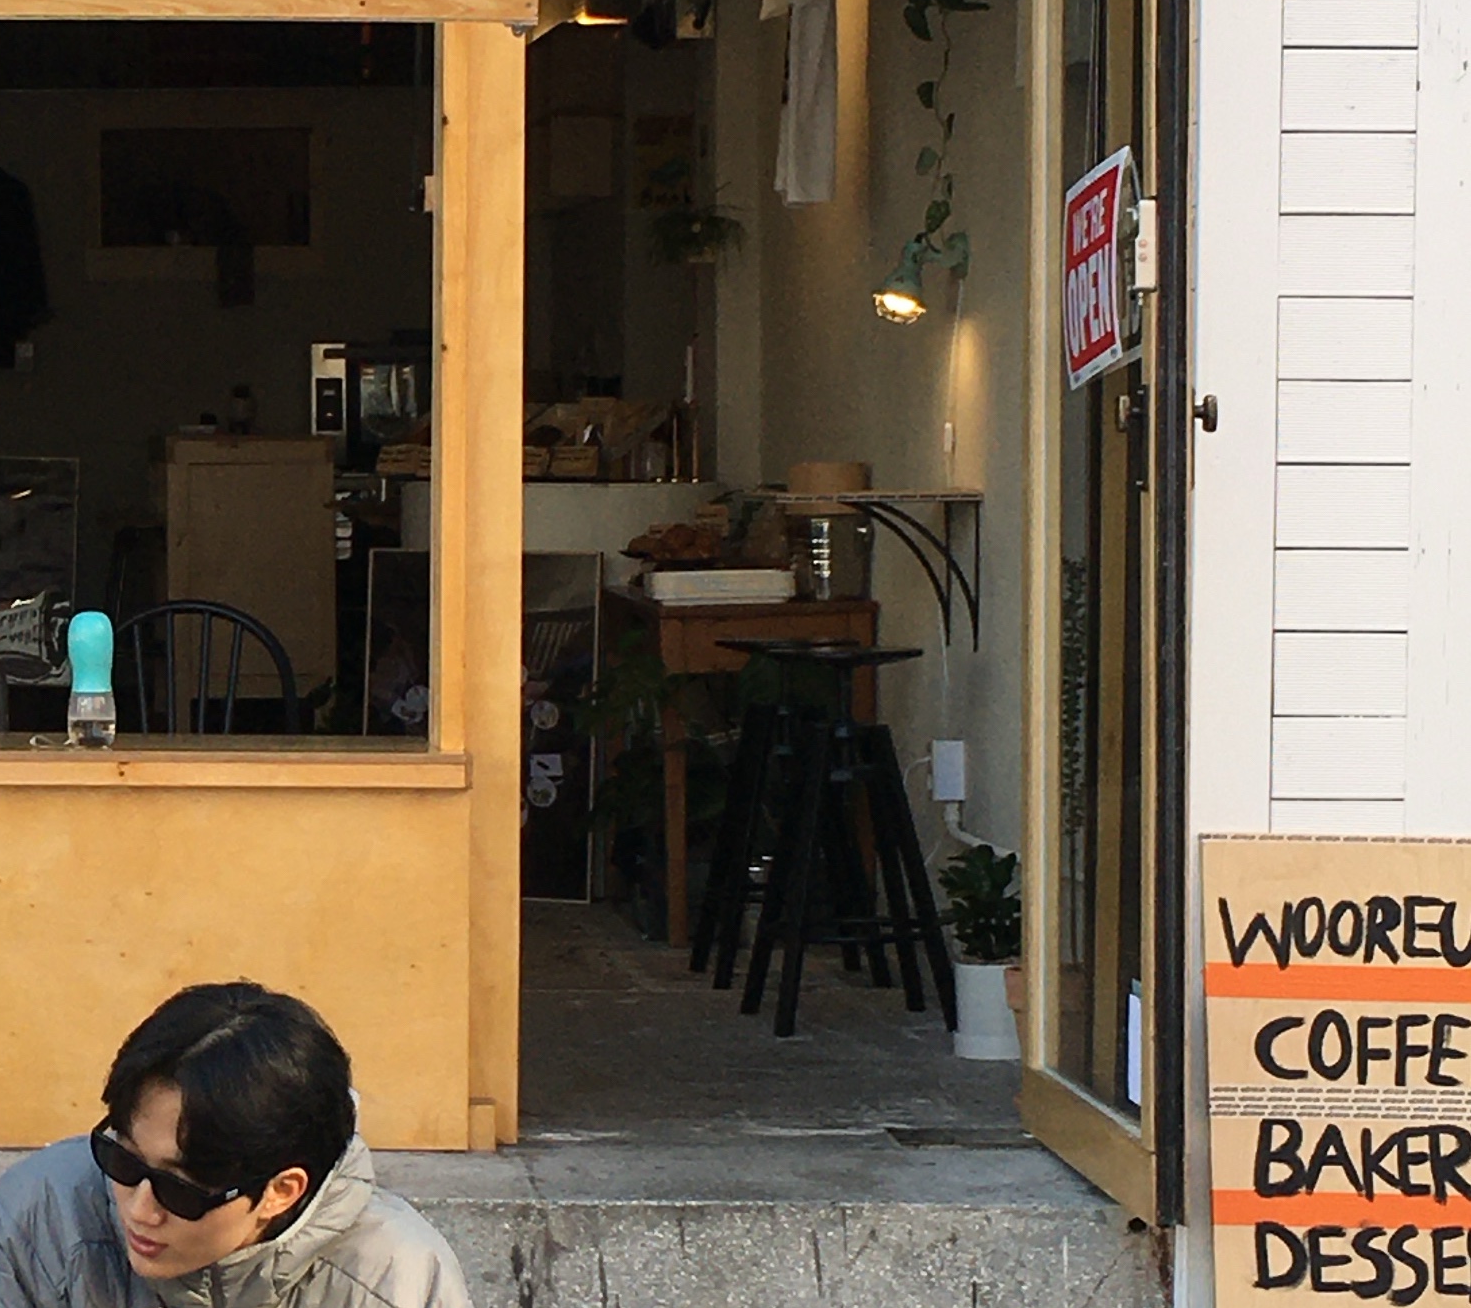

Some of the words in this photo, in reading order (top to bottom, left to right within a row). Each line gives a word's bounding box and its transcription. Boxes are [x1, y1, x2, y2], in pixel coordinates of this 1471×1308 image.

[1067, 243, 1112, 358] OPEN
[1254, 1008, 1471, 1087] COFFE
[1253, 1118, 1471, 1205] BAKER
[1251, 1220, 1471, 1307] DESSE
